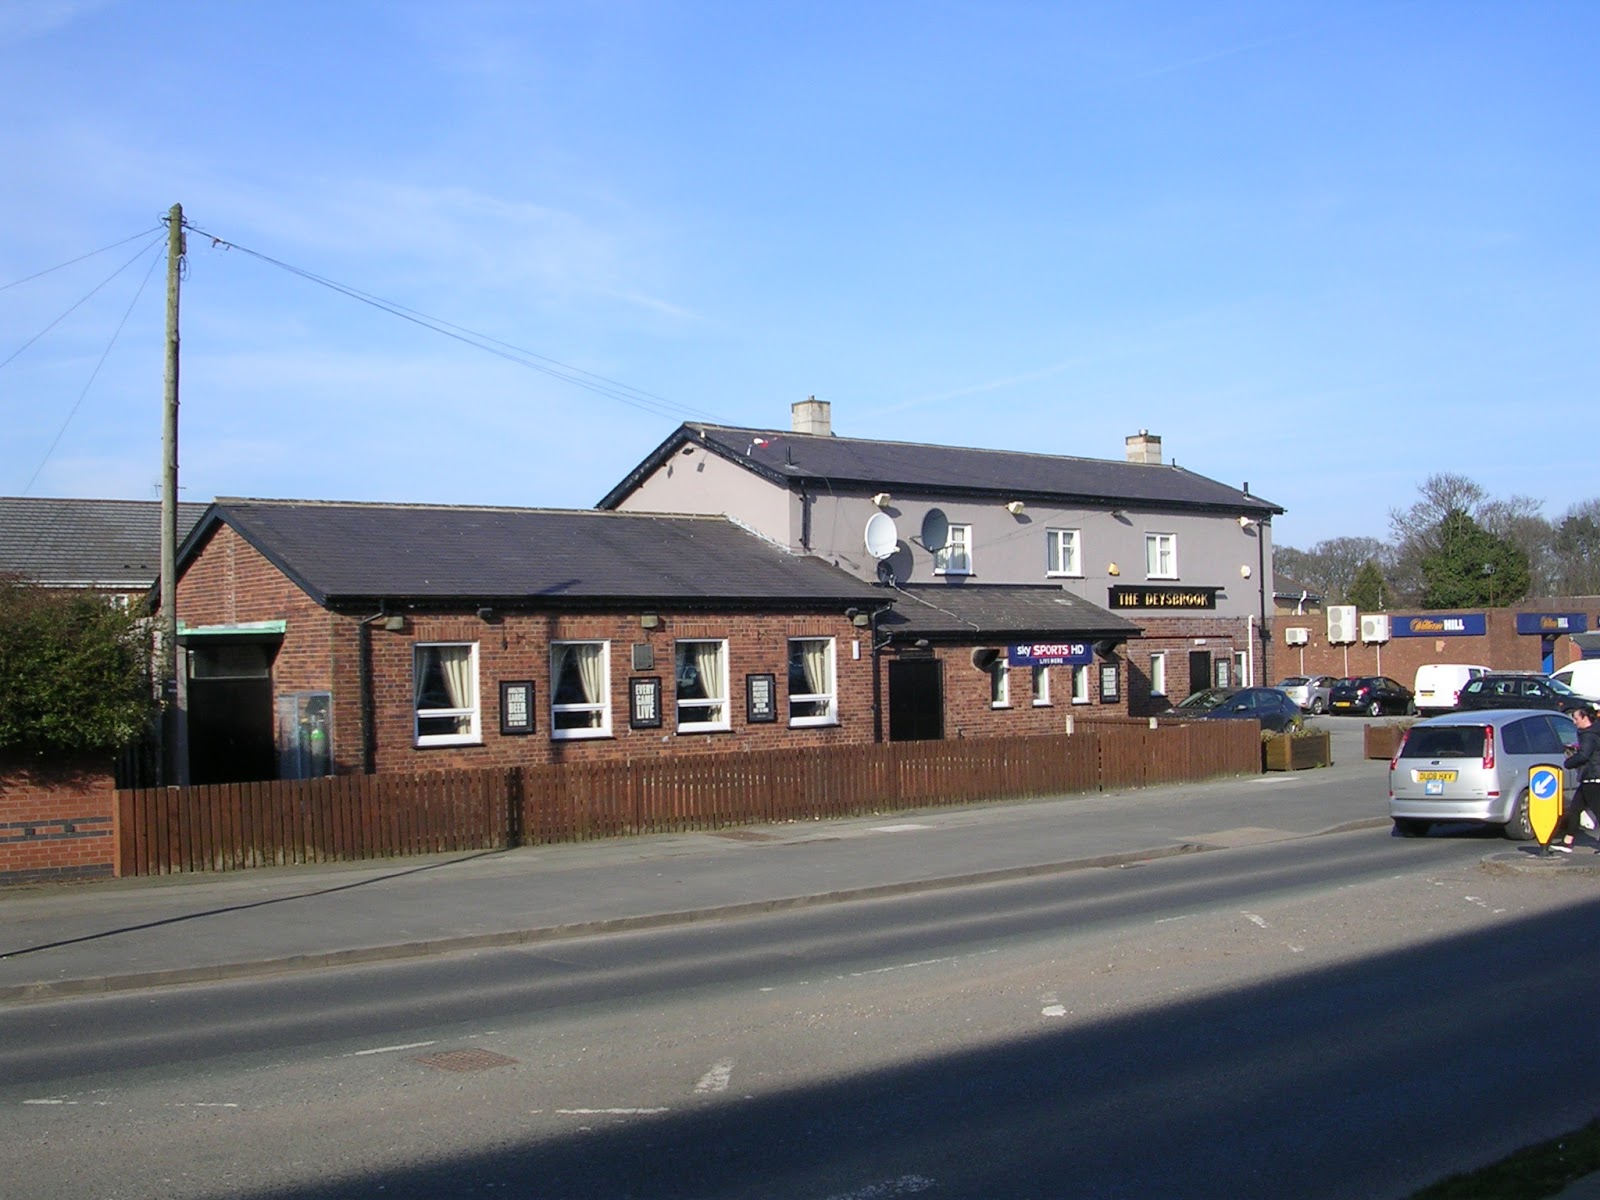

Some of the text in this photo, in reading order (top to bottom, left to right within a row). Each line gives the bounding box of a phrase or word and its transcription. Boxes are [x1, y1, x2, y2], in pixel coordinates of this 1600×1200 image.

[1118, 592, 1208, 606] THE DEYSBROOK
[1443, 619, 1465, 630] HILL
[1017, 644, 1085, 657] sky SPORTS HD
[635, 684, 655, 695] EVERY
[637, 705, 655, 719] LIVE
